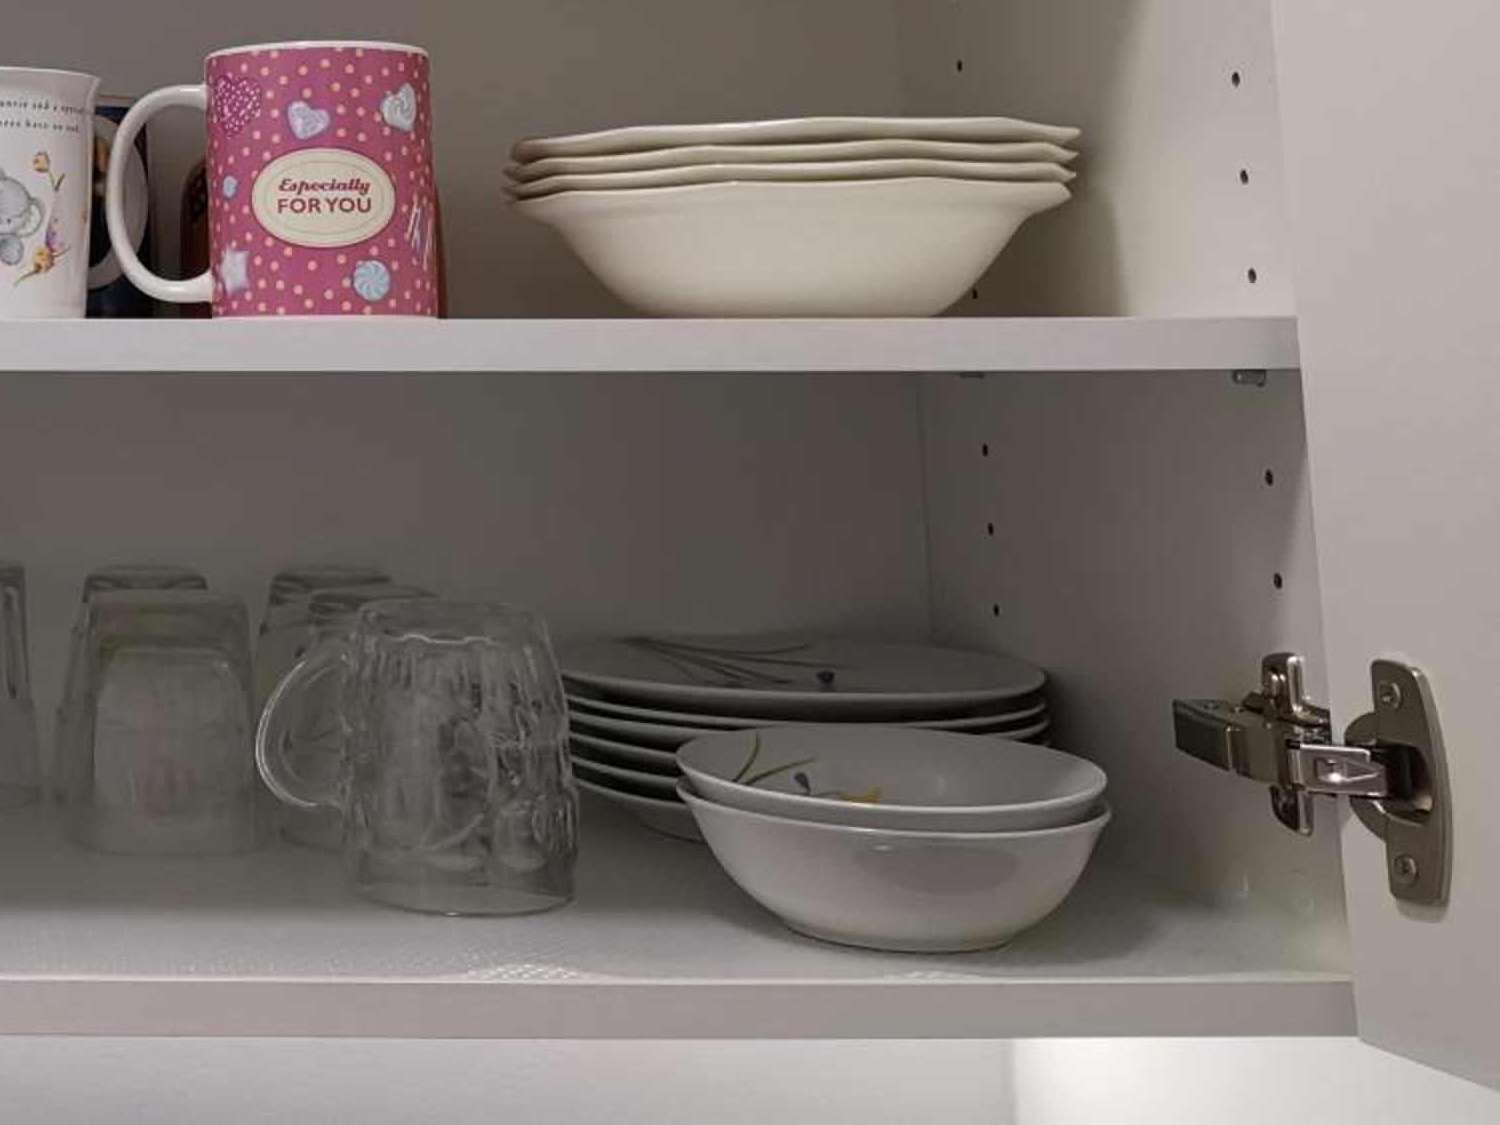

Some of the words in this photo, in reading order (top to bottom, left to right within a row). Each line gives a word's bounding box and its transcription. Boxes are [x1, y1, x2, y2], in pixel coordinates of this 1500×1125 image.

[32, 99, 50, 110] and
[25, 118, 49, 129] have
[278, 178, 371, 196] Especially
[277, 198, 322, 214] FOR
[324, 197, 372, 214] YOU
